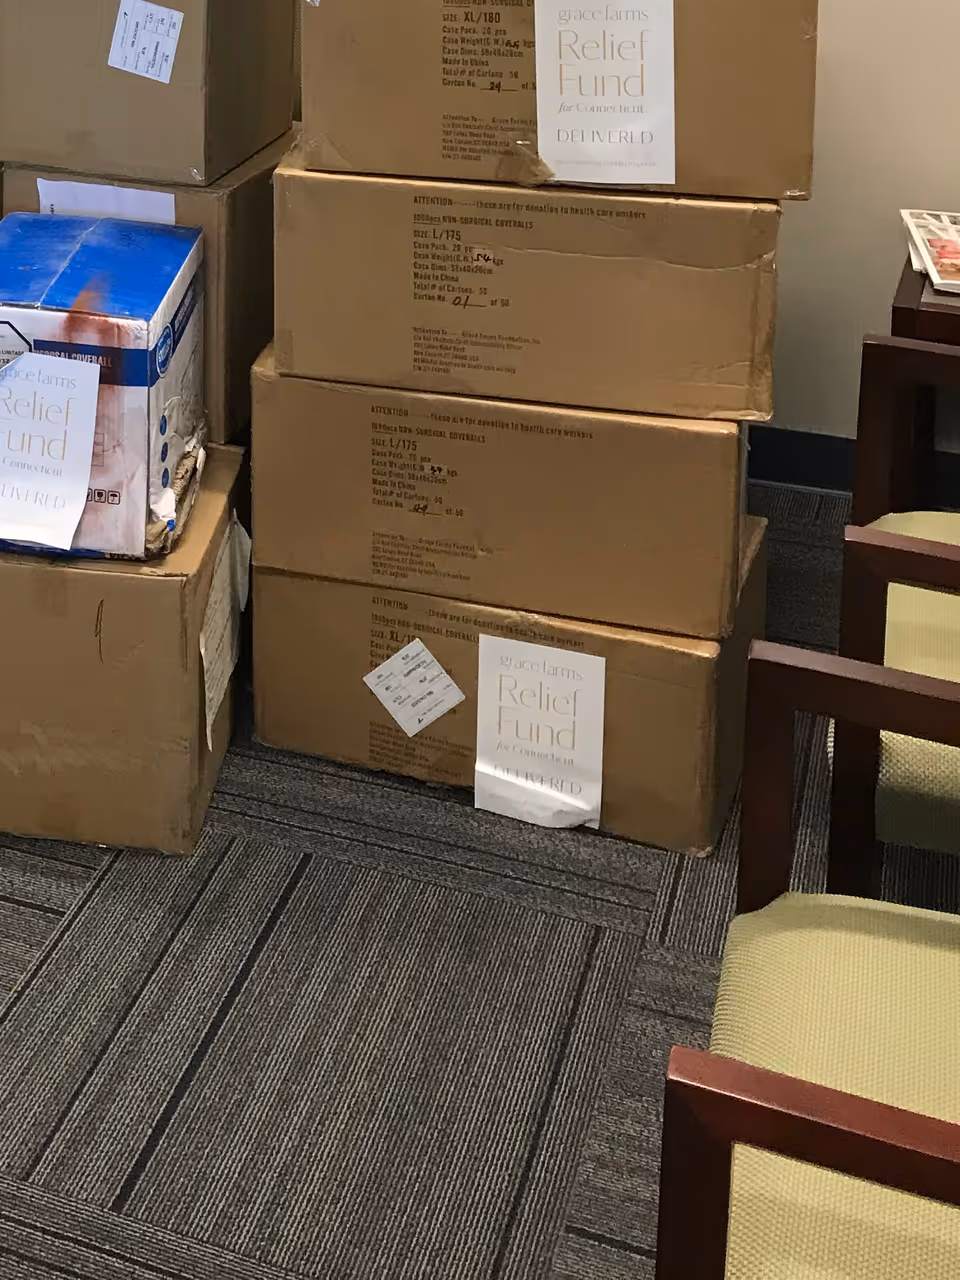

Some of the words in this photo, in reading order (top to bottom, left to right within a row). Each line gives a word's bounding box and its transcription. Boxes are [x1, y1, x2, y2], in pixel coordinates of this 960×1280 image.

[464, 11, 501, 23] XL/180
[558, 8, 602, 25] grace
[557, 29, 652, 60] Relief
[558, 63, 644, 97] Fund
[557, 129, 653, 145] DELIVERED
[414, 196, 453, 206] ATTENTION
[525, 203, 558, 213] donation
[570, 206, 595, 216] health
[596, 209, 613, 217] care
[615, 209, 646, 218] workers
[495, 219, 533, 229] COVERALLS
[433, 228, 461, 241] L/175
[371, 406, 409, 417] ATTENTION
[390, 438, 417, 451] L/175
[372, 596, 408, 611] ATTENTION
[498, 674, 581, 717] Relief
[497, 706, 576, 751] Fund
